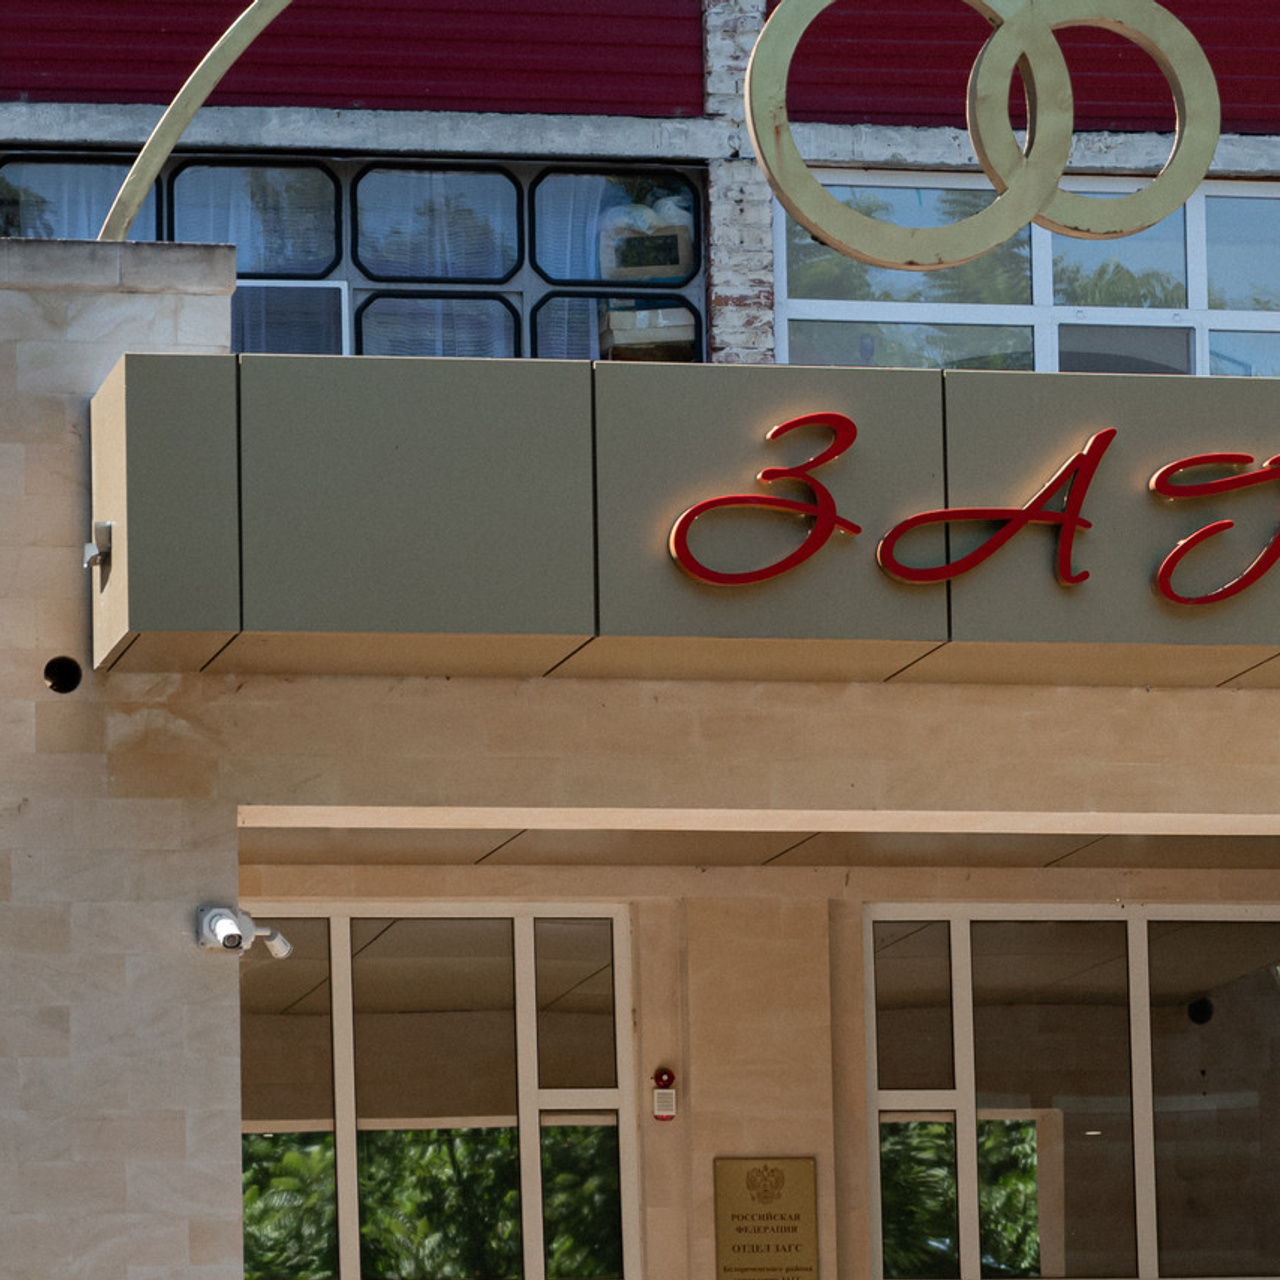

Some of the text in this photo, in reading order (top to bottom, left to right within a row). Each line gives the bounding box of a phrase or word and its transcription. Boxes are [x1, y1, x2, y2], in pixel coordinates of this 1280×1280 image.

[731, 1211, 801, 1222] РОССИЙСКАЯ
[735, 1225, 798, 1234] ФЕДЕРАЦИЯ
[731, 1243, 804, 1253] ОТДЕЛ ЗАГС
